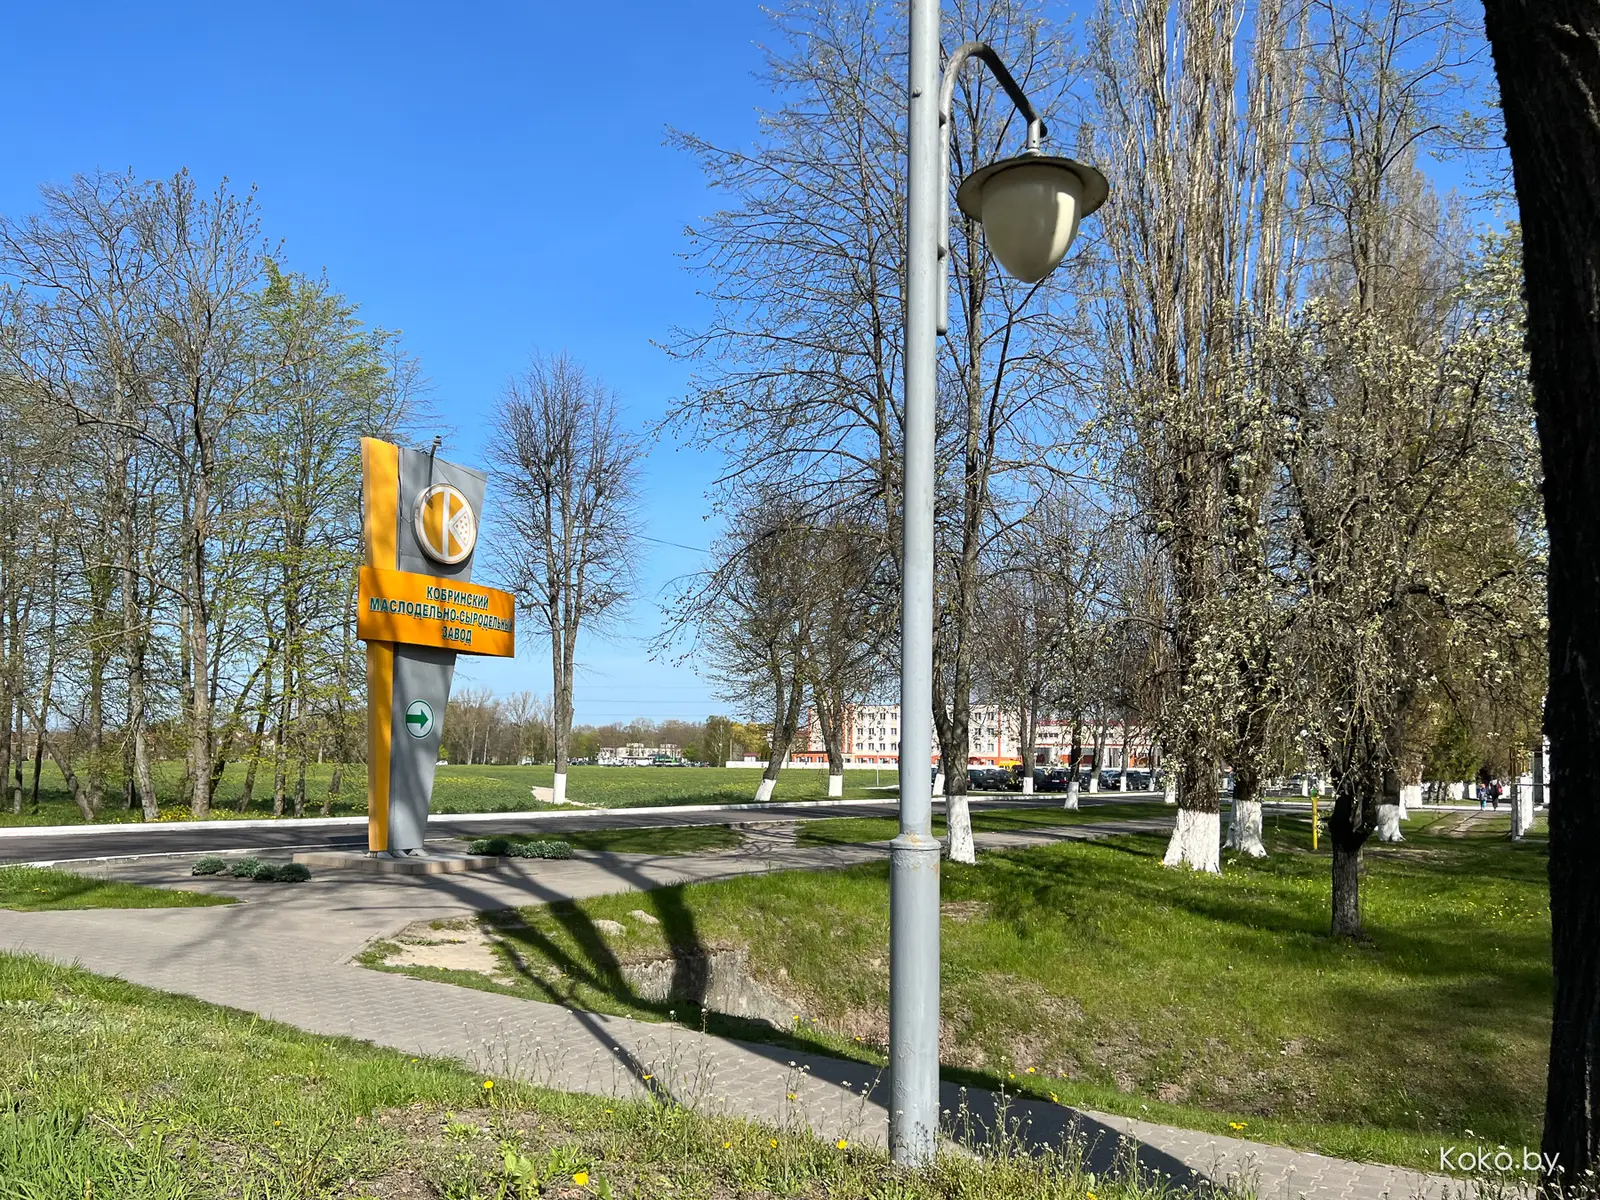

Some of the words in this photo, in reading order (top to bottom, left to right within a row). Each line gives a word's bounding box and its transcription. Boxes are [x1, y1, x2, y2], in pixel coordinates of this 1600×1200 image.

[427, 586, 489, 609] КОБРИНСКИЙ
[370, 598, 513, 632] МАСЛОДЕЛЬНО-СЫРОДЕЛЬНЫЙ
[442, 626, 472, 645] ЗАВОД
